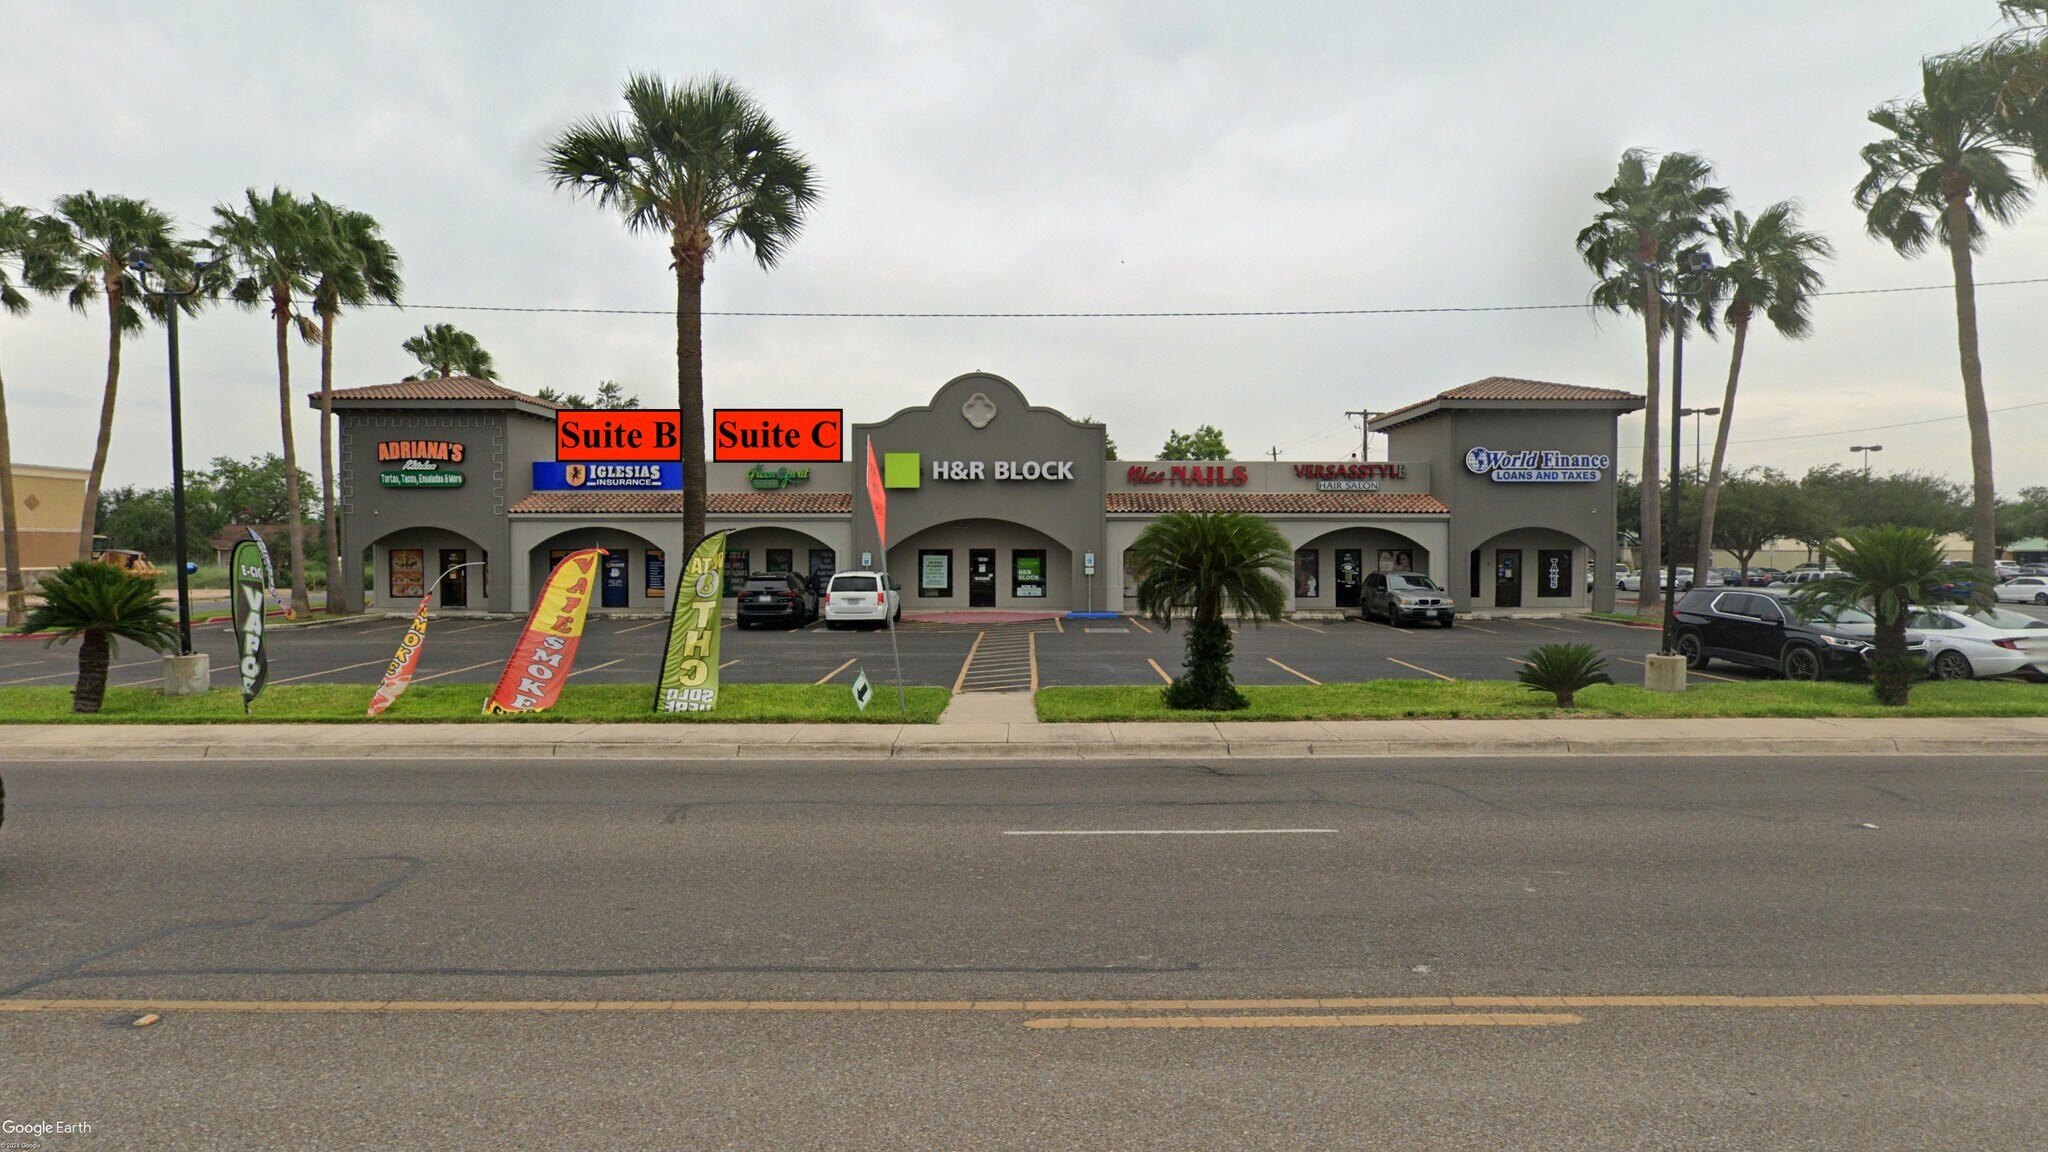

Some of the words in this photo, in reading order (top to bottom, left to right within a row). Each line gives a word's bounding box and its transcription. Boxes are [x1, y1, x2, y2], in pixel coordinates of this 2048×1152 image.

[379, 440, 463, 462] ADRIANA'S
[1486, 451, 1539, 468] World
[1541, 451, 1609, 468] Finance
[590, 465, 660, 479] IGLESIAS
[933, 461, 985, 480] H&R
[994, 461, 1074, 480] BLOCK
[1127, 466, 1166, 484] Nice
[1170, 466, 1249, 486] NAILS
[1496, 471, 1533, 480] LOANS
[1536, 471, 1559, 480] AND
[1561, 471, 1597, 480] TAXES
[1549, 558, 1560, 589] TAXES
[551, 556, 595, 634] VAPE
[510, 636, 566, 709] SMOKE
